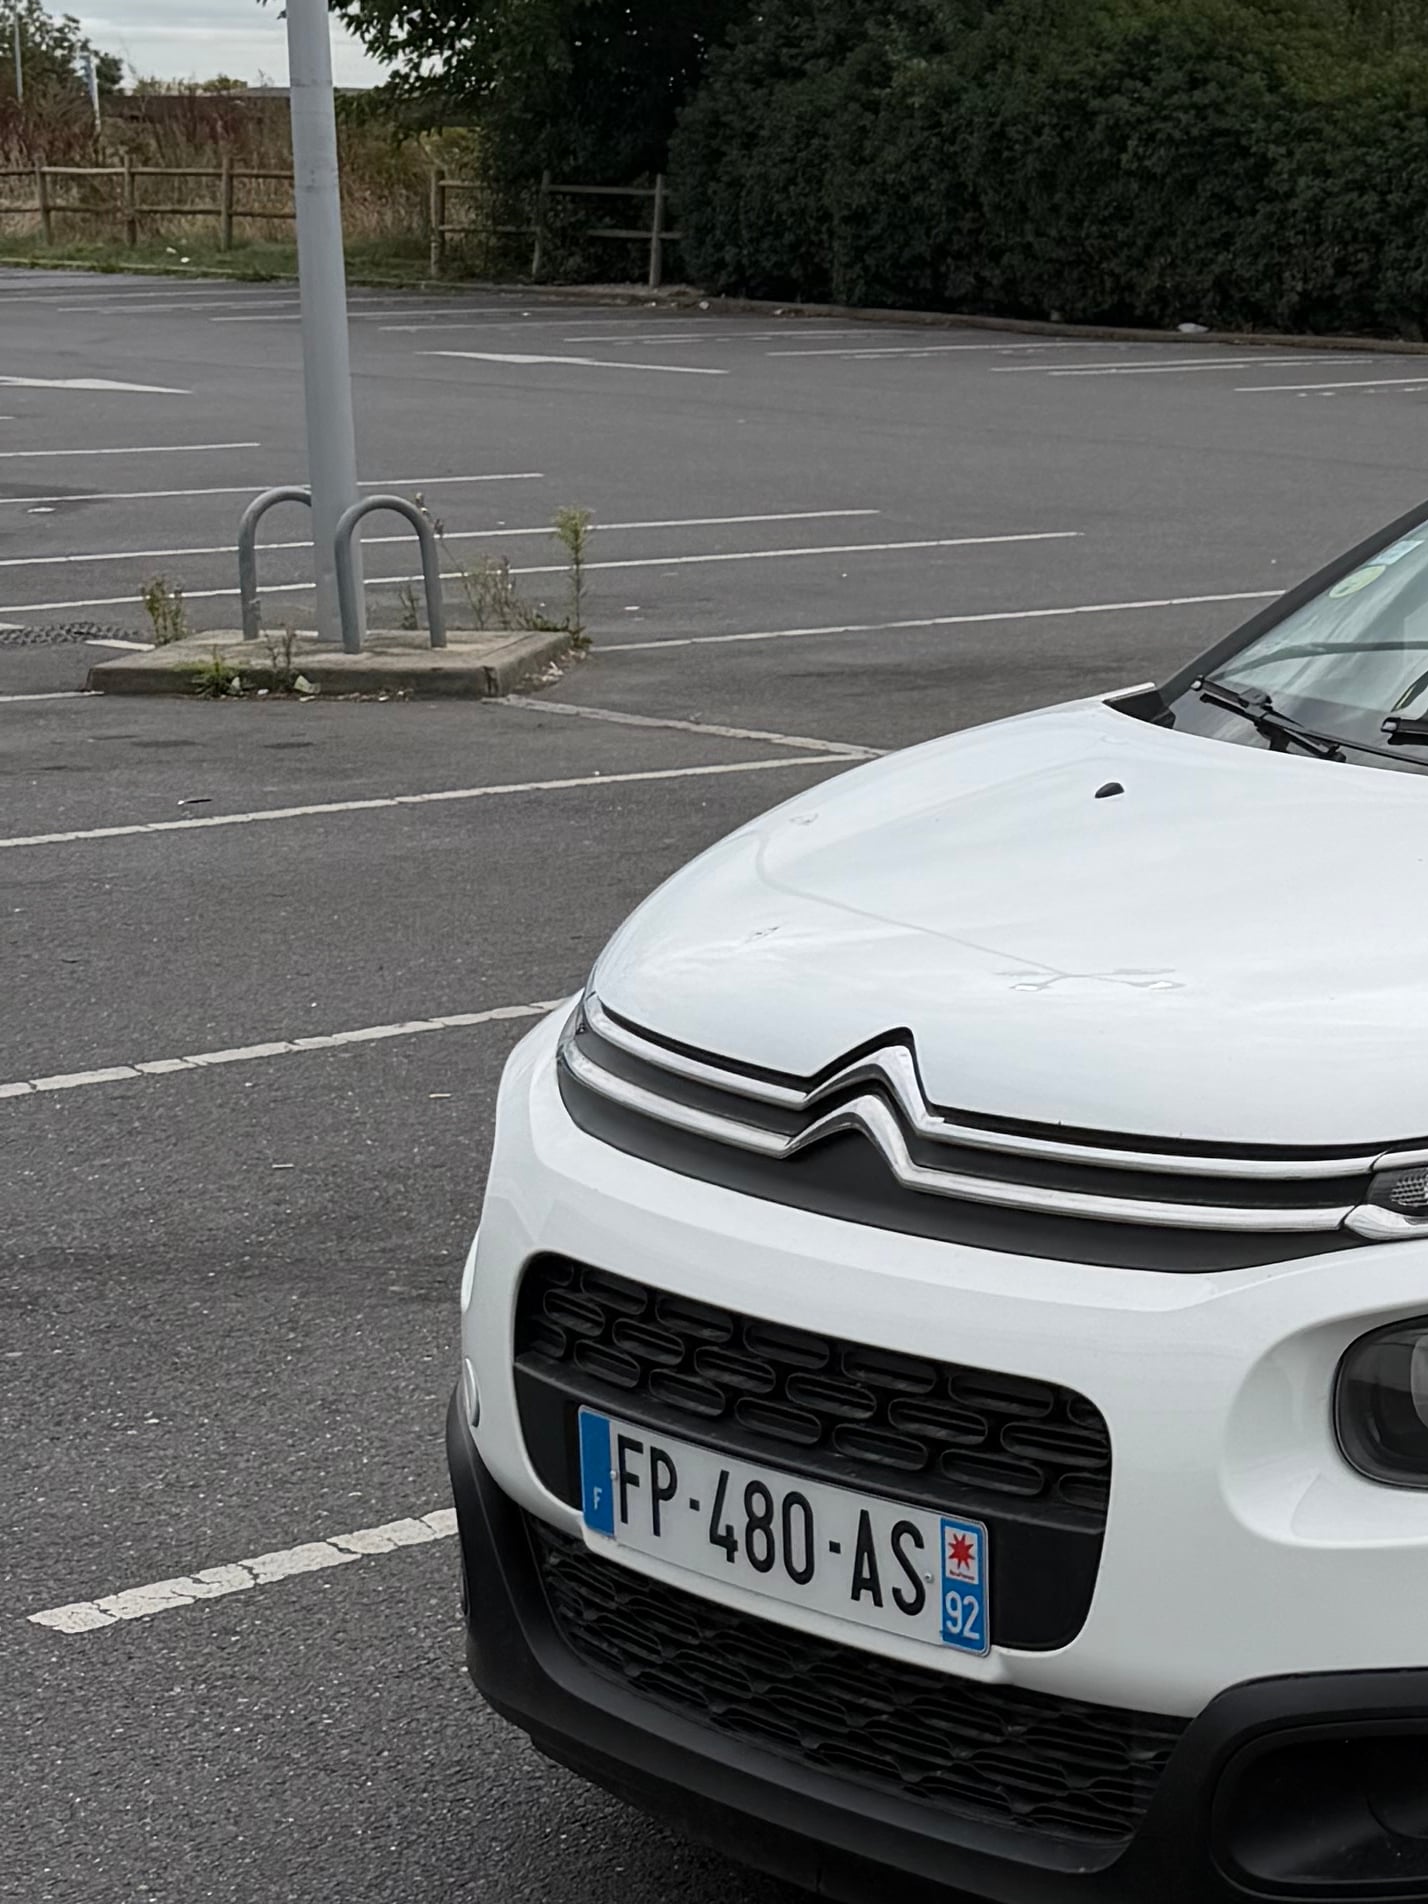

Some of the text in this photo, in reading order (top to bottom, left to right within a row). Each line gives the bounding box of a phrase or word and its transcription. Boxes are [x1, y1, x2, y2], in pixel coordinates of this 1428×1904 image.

[593, 1486, 603, 1510] F
[617, 1434, 926, 1616] FP-480-AS
[945, 1590, 980, 1641] 92
